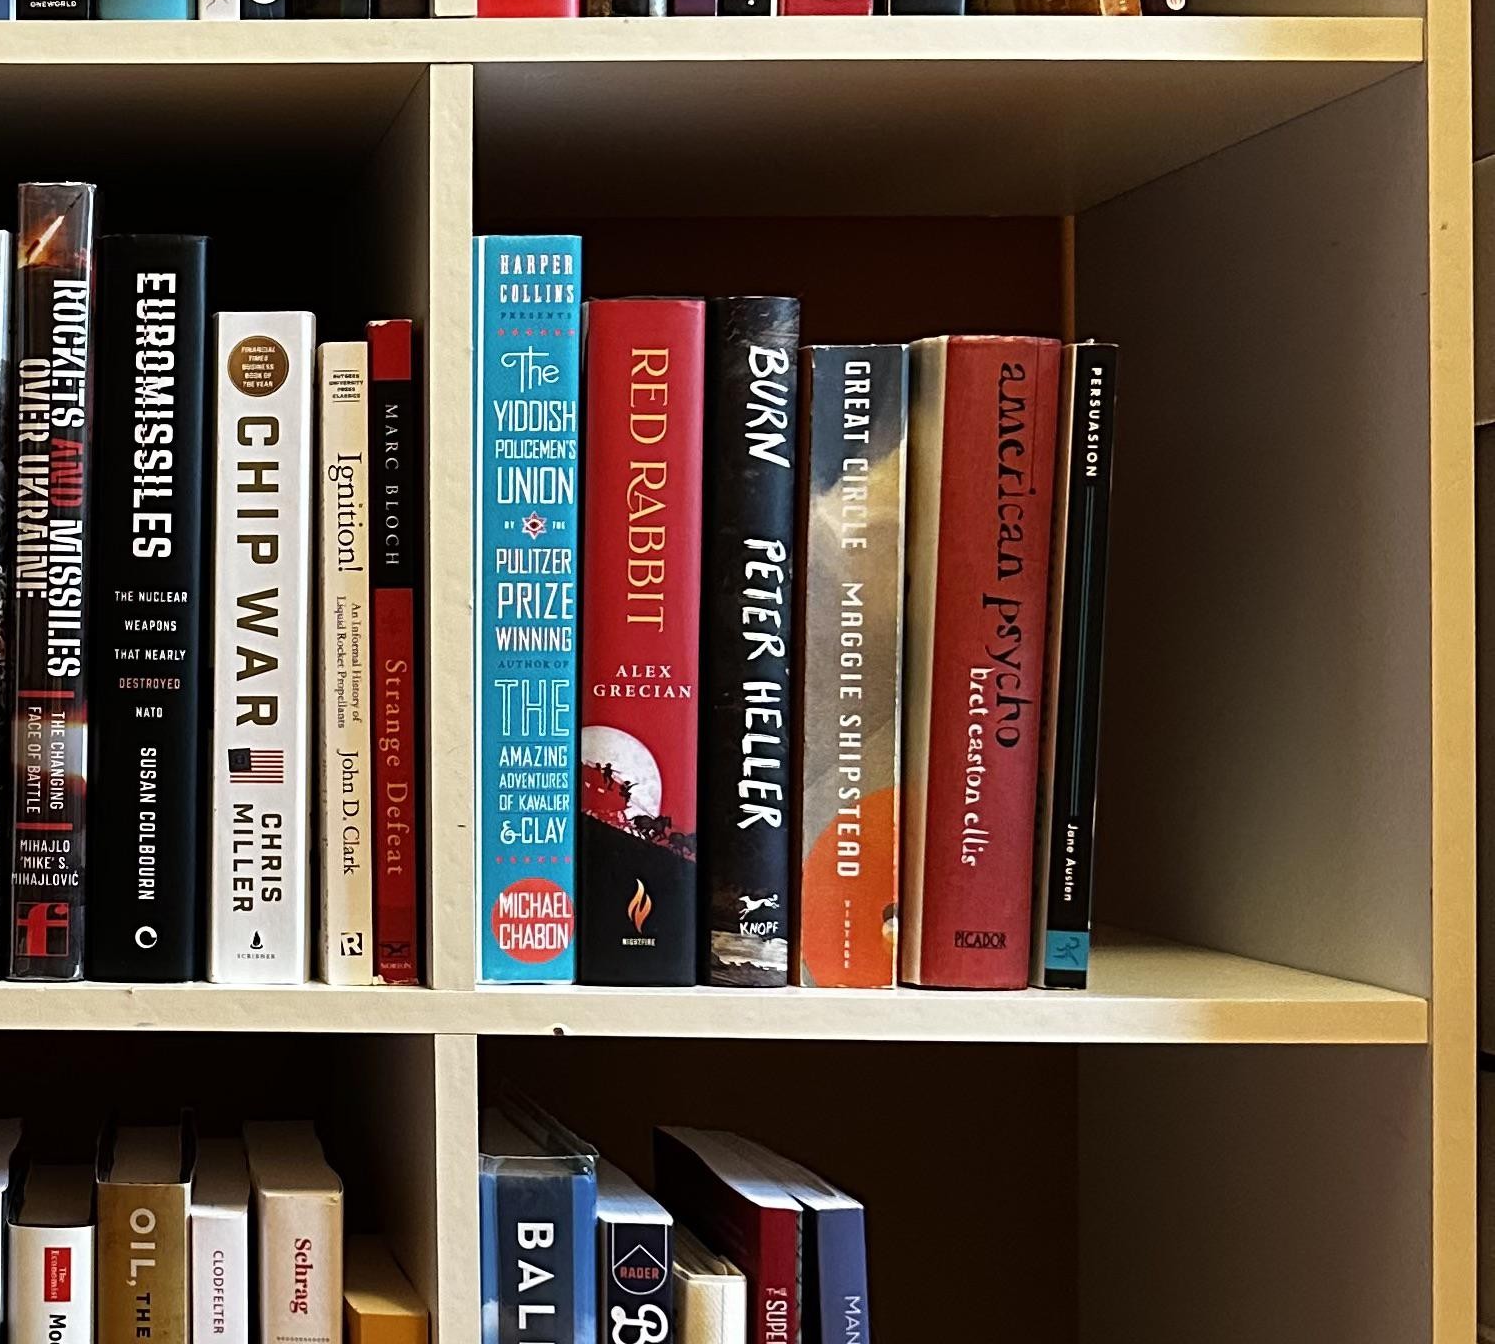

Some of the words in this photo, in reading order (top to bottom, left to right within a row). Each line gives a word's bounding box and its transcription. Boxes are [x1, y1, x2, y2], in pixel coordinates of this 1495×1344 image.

[132, 272, 176, 558] EUROMISSILES
[630, 348, 668, 444] RED
[746, 345, 790, 468] BURN
[843, 361, 870, 444] GREAT
[1086, 367, 1102, 478] PERSUASION
[236, 416, 278, 565] CHIP
[842, 458, 869, 549] CIRCLE
[995, 362, 1035, 580] american
[626, 460, 667, 632] RABBIT
[741, 538, 786, 658] PETER
[236, 588, 279, 728] WAR
[983, 593, 1032, 748] psycho
[338, 749, 358, 791] John
[738, 680, 784, 830] HELLER
[341, 798, 358, 820] D.
[342, 826, 360, 875] Clark
[1064, 824, 1078, 852] Jane
[498, 894, 573, 919] MICHAEL
[1064, 858, 1076, 901] Austen
[498, 924, 571, 950] CHABON
[127, 1209, 156, 1286] OIL,
[290, 1238, 313, 1314] Schrag
[136, 1293, 151, 1338] THE
